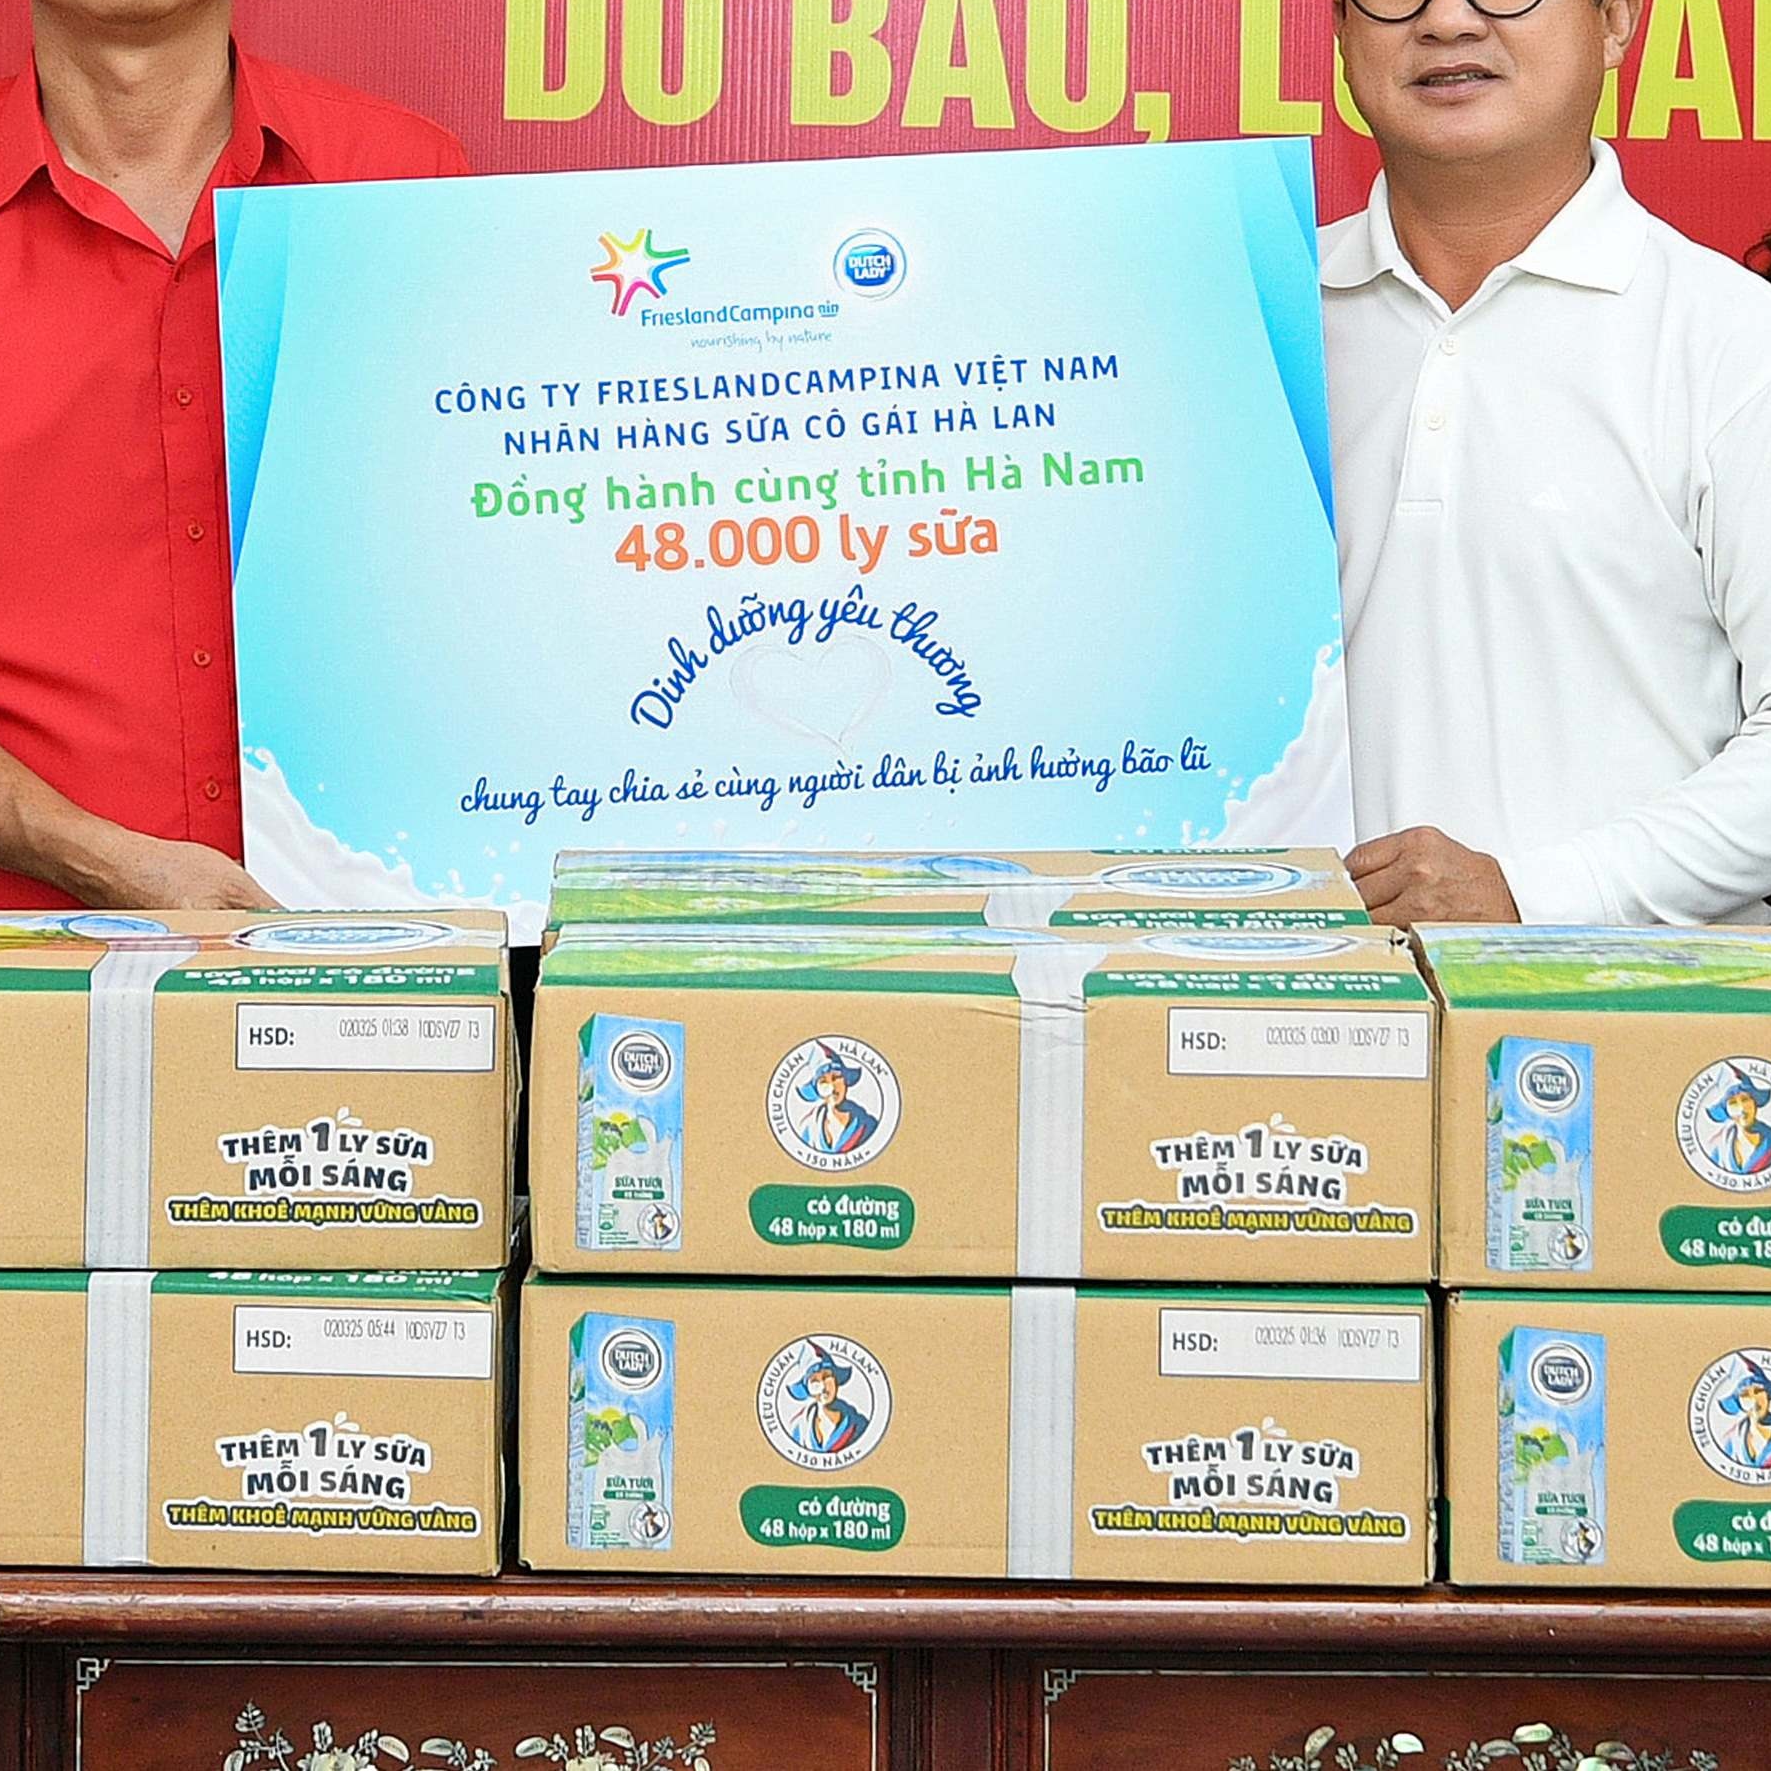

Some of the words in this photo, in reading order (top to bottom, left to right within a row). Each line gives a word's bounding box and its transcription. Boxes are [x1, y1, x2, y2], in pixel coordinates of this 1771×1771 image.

[848, 254, 891, 270] DUTCH
[854, 267, 886, 280] LADY
[640, 303, 814, 327] FrieslandCampina
[690, 333, 763, 354] nourishing
[765, 330, 784, 347] by
[788, 329, 833, 345] nature
[435, 382, 526, 414] CÔNG
[541, 383, 580, 408] TY
[598, 365, 940, 405] FRIESLANDCAMPINA
[954, 354, 1027, 392] VIỆT
[1044, 355, 1118, 382] NAM
[617, 418, 709, 449] HÀNG
[725, 412, 790, 444] SỮA
[805, 408, 846, 439] CÔ
[862, 404, 918, 436] GÁI
[934, 401, 977, 433] HÀ
[994, 403, 1055, 429] LAN
[471, 474, 587, 524] Đồng
[606, 472, 715, 511] hành
[734, 468, 839, 511] cùng
[857, 459, 946, 498] tỉnh
[966, 455, 1023, 491] Hà
[1043, 452, 1145, 486] Nam
[615, 515, 821, 572] 48.000
[839, 514, 890, 575] ly
[908, 508, 999, 558] sữa
[630, 637, 709, 729] Dinh
[707, 593, 815, 655] dưỡng
[815, 584, 884, 643] yêu
[890, 602, 984, 718] thương
[460, 777, 545, 826] chung
[549, 775, 603, 822] tay
[609, 768, 670, 804] chia
[675, 769, 709, 800] sẻ
[715, 766, 782, 812] cùng
[788, 760, 865, 809] người
[872, 754, 927, 789] dân
[933, 750, 963, 794] bị
[969, 746, 1023, 783] ảnh
[1030, 745, 1118, 793] hưởng
[1122, 739, 1175, 774] bão
[1180, 736, 1213, 771] lũ
[249, 1028, 294, 1046] HSD:
[223, 1131, 302, 1158] THÊM
[311, 1123, 330, 1152] 1
[339, 1134, 368, 1153] LY
[377, 1133, 428, 1160] SỮA
[1155, 1137, 1235, 1164] THÊM
[1244, 1130, 1263, 1159] 1
[1272, 1142, 1302, 1160] LY
[1310, 1141, 1362, 1168] SỮA
[249, 1156, 312, 1190] MỖI
[322, 1160, 408, 1192] SÁNG
[1182, 1162, 1245, 1198] MỖI
[1255, 1167, 1341, 1200] SÁNG
[171, 1198, 228, 1220] THÊM
[294, 1202, 354, 1225] MẠNH
[360, 1200, 415, 1220] VỮNG
[421, 1200, 476, 1221] VÀNG
[808, 1196, 831, 1215] có
[836, 1194, 900, 1220] đường
[768, 1218, 794, 1236] 48
[799, 1220, 827, 1240] hộp
[827, 1225, 838, 1237] x
[843, 1219, 878, 1238] 180
[880, 1223, 900, 1238] ml
[1718, 1216, 1742, 1236] có
[246, 1330, 292, 1348] HSD:
[221, 1435, 300, 1462] THÊM
[309, 1428, 328, 1457] 1
[337, 1440, 366, 1459] LY
[375, 1439, 426, 1466] SỮA
[1146, 1439, 1226, 1466] THÊM
[1235, 1432, 1254, 1461] 1
[1263, 1444, 1293, 1463] LY
[1302, 1443, 1353, 1470] SỮA
[247, 1460, 309, 1496] MỖI
[320, 1466, 405, 1499] SÁNG
[1173, 1464, 1236, 1500] MỖI
[1246, 1470, 1333, 1503] SÁNG
[798, 1496, 822, 1515] có
[826, 1495, 891, 1521] đường
[1732, 1511, 1756, 1530] có
